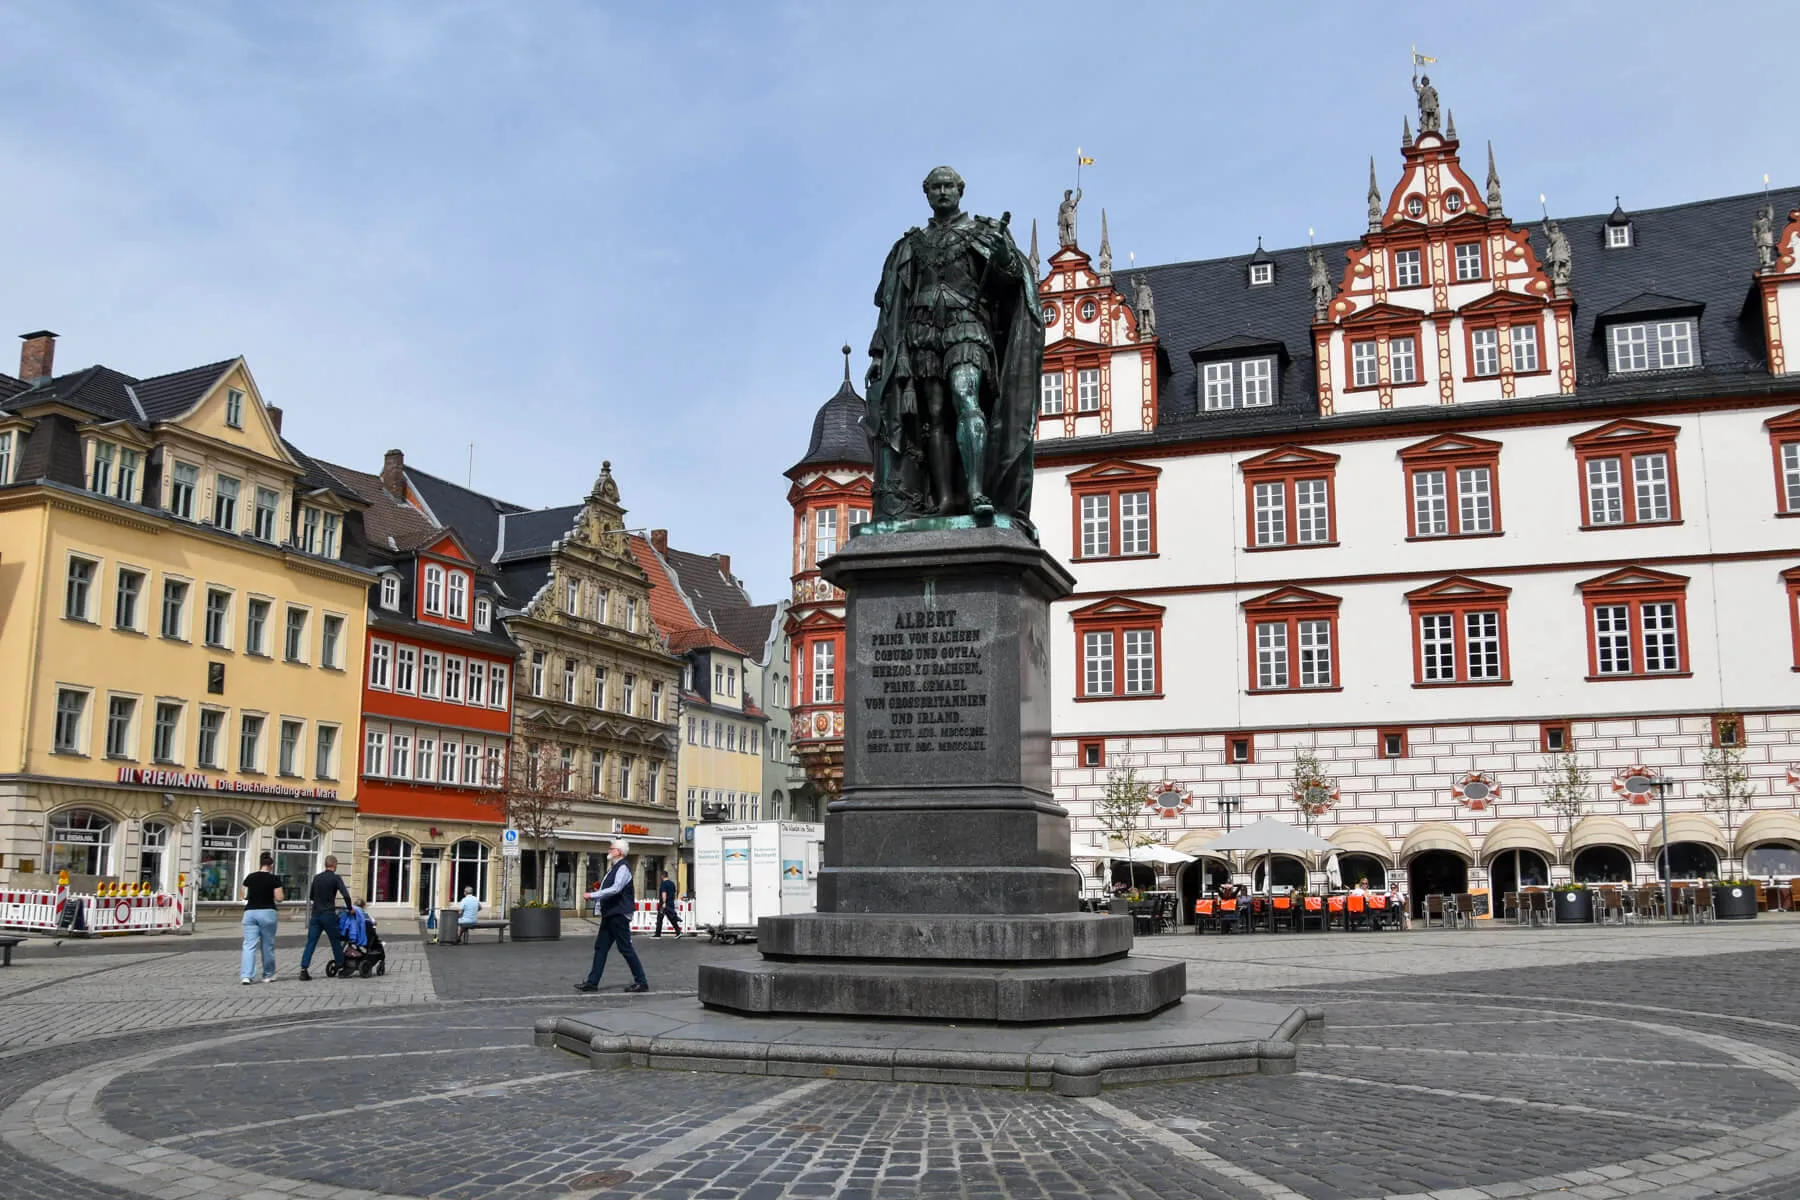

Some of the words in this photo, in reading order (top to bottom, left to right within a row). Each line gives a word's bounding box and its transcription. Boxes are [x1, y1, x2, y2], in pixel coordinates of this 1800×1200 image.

[895, 610, 957, 629] ALBERT
[872, 633, 904, 646] PRINZ
[909, 632, 929, 644] VON
[932, 630, 980, 643] SACHSEN
[875, 649, 913, 661] COBURG
[916, 648, 937, 659] UND
[941, 646, 982, 659] GOTHA,
[872, 665, 911, 677] HERZOG
[865, 698, 885, 710] VON
[891, 712, 913, 724] UND
[218, 779, 233, 791] Die
[236, 781, 300, 798] Buchhandlung
[301, 789, 313, 797] am
